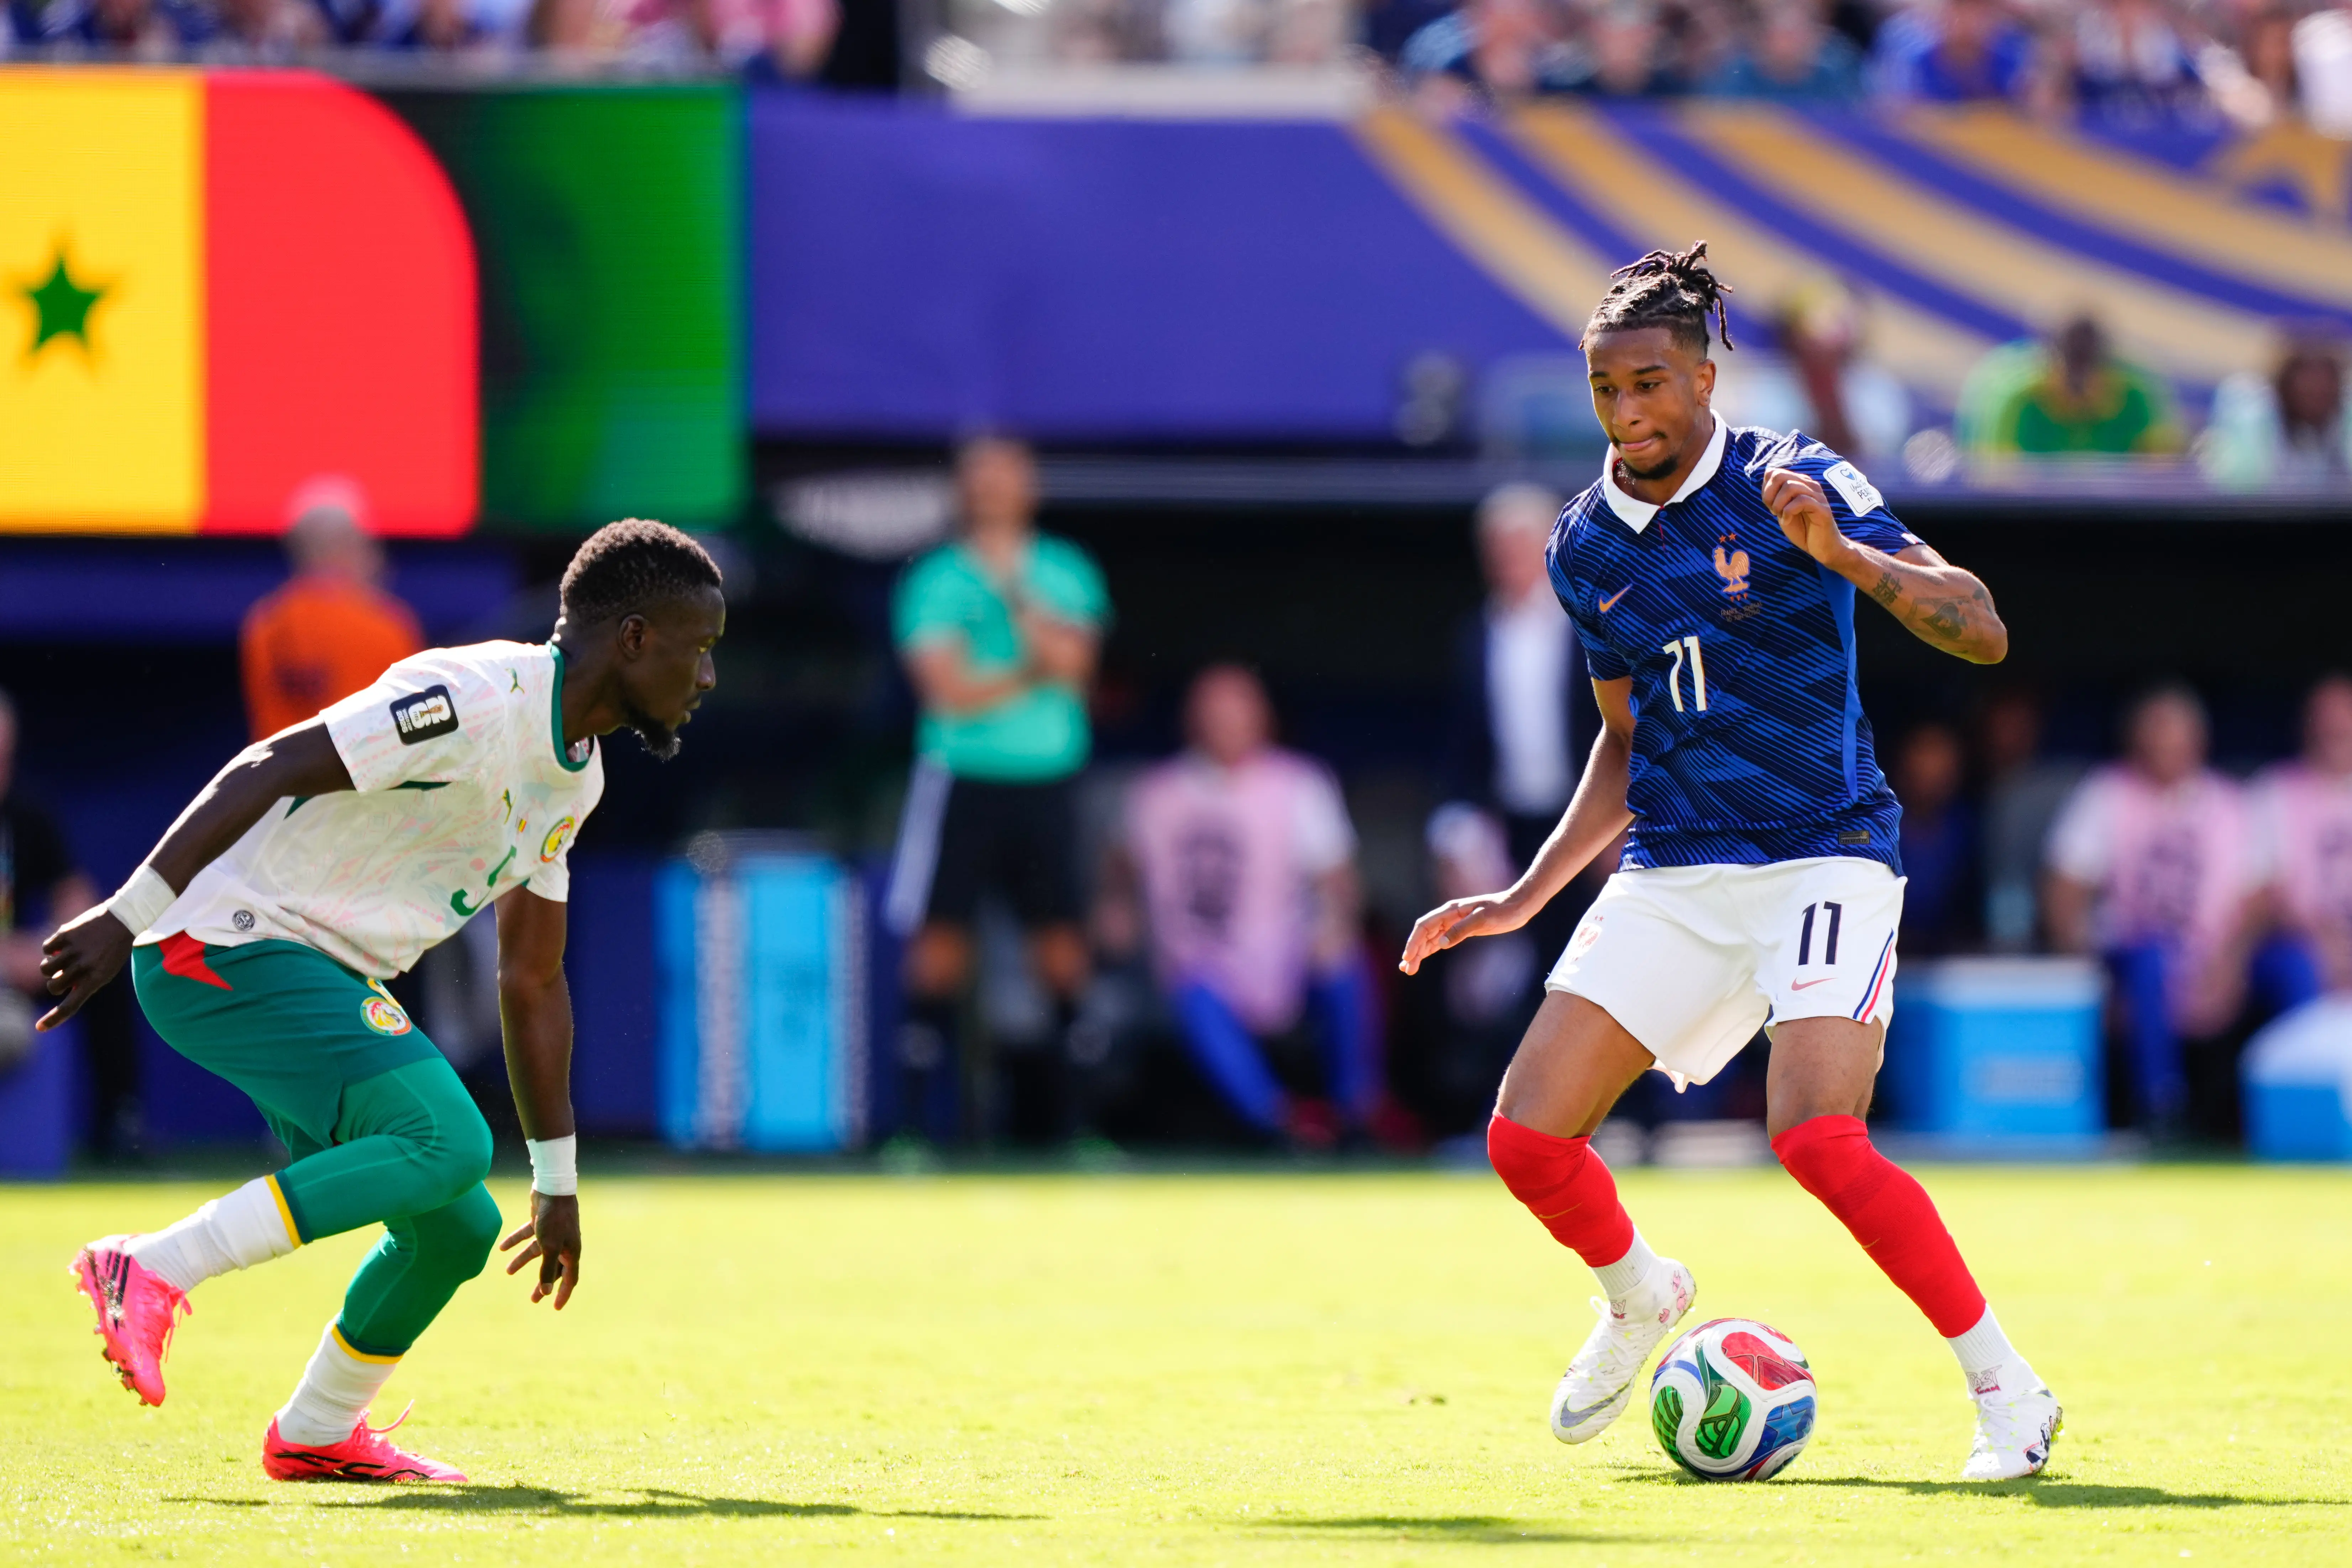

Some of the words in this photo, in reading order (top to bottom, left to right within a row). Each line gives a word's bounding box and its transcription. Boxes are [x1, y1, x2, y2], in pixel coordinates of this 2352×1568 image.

[1662, 636, 1707, 712] 11
[396, 709, 408, 733] 2026
[1798, 901, 1843, 966] 11
